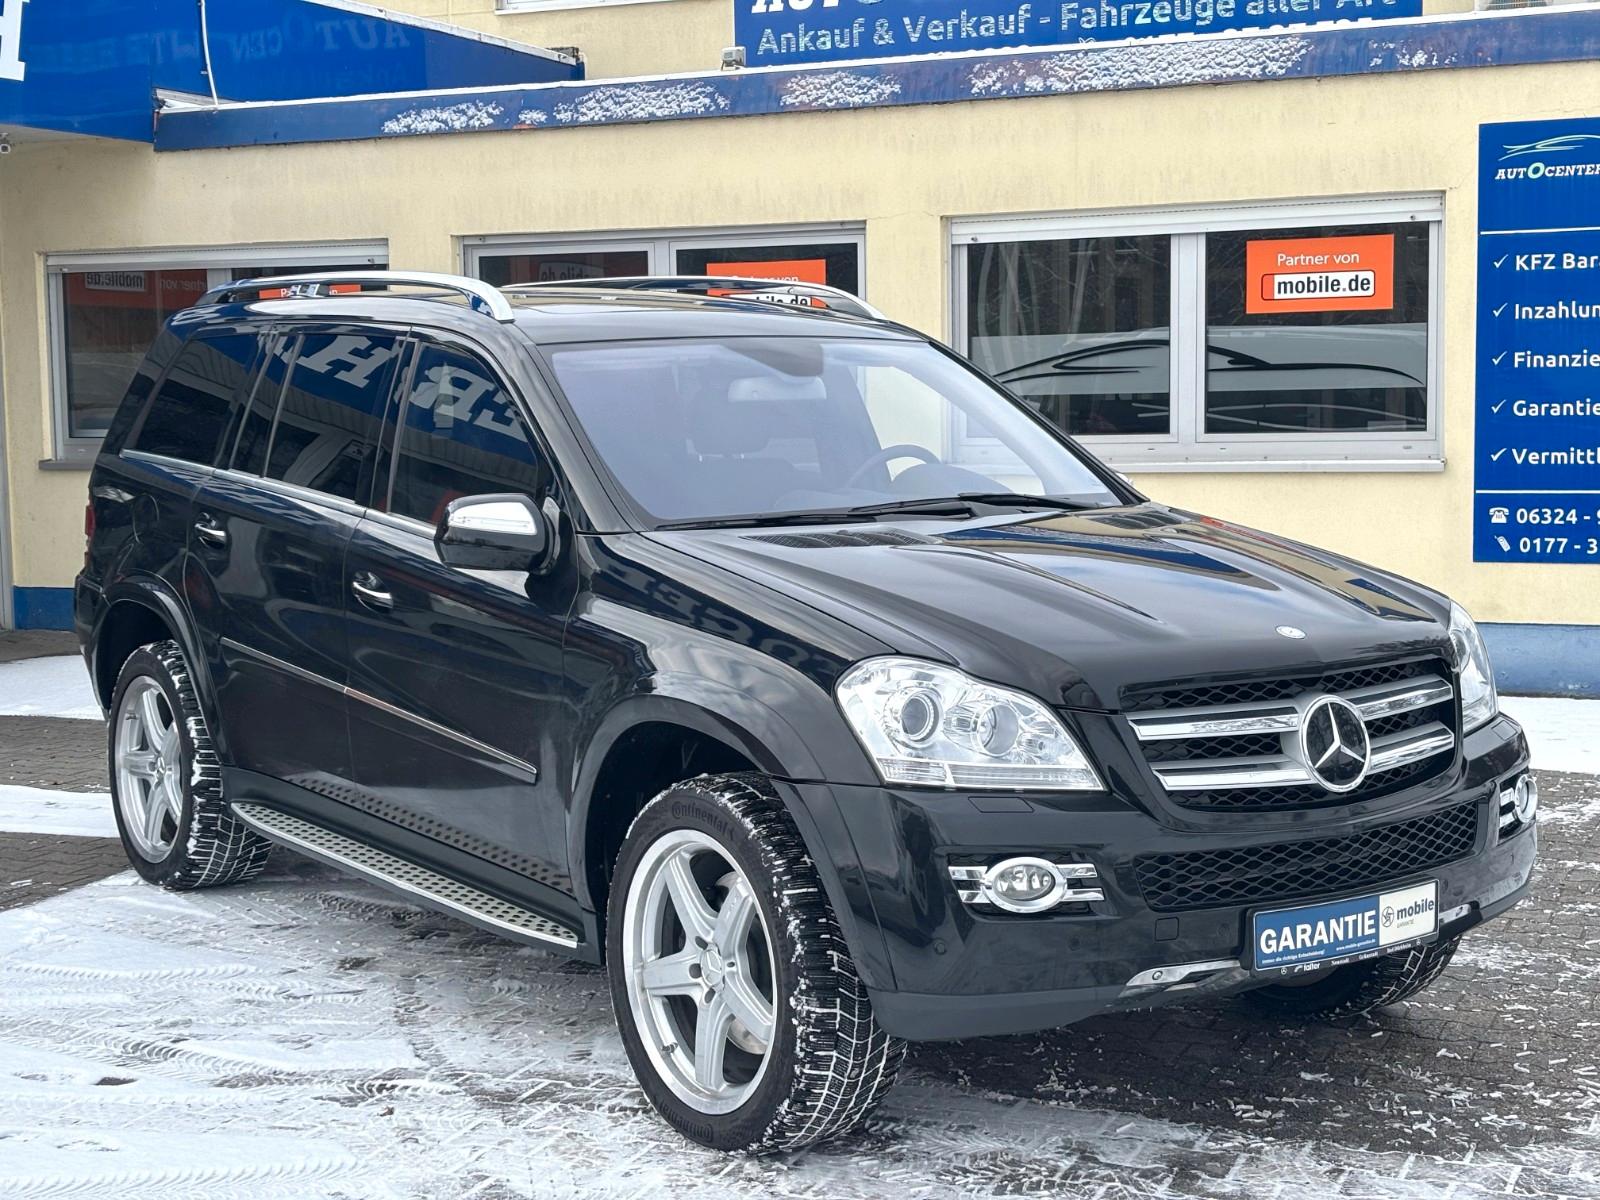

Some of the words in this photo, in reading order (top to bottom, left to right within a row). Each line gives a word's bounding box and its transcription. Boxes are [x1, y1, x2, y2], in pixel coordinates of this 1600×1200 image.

[757, 18, 865, 55] Ankauf
[873, 18, 895, 46] &
[903, 3, 1031, 43] Verkauf
[1061, 0, 1235, 30] Fahrzeuge
[1277, 253, 1330, 266] Partner
[1334, 253, 1360, 264] von
[1515, 253, 1556, 271] KFZ
[1563, 252, 1600, 269] Bar
[1277, 274, 1371, 295] mobile.de
[1514, 349, 1600, 368] Finanzie
[1513, 398, 1600, 417] Garantie
[1516, 508, 1578, 525] 06324
[1519, 537, 1568, 553] 0177
[1260, 910, 1377, 954] GARANTIE
[1396, 897, 1435, 920] mobile
